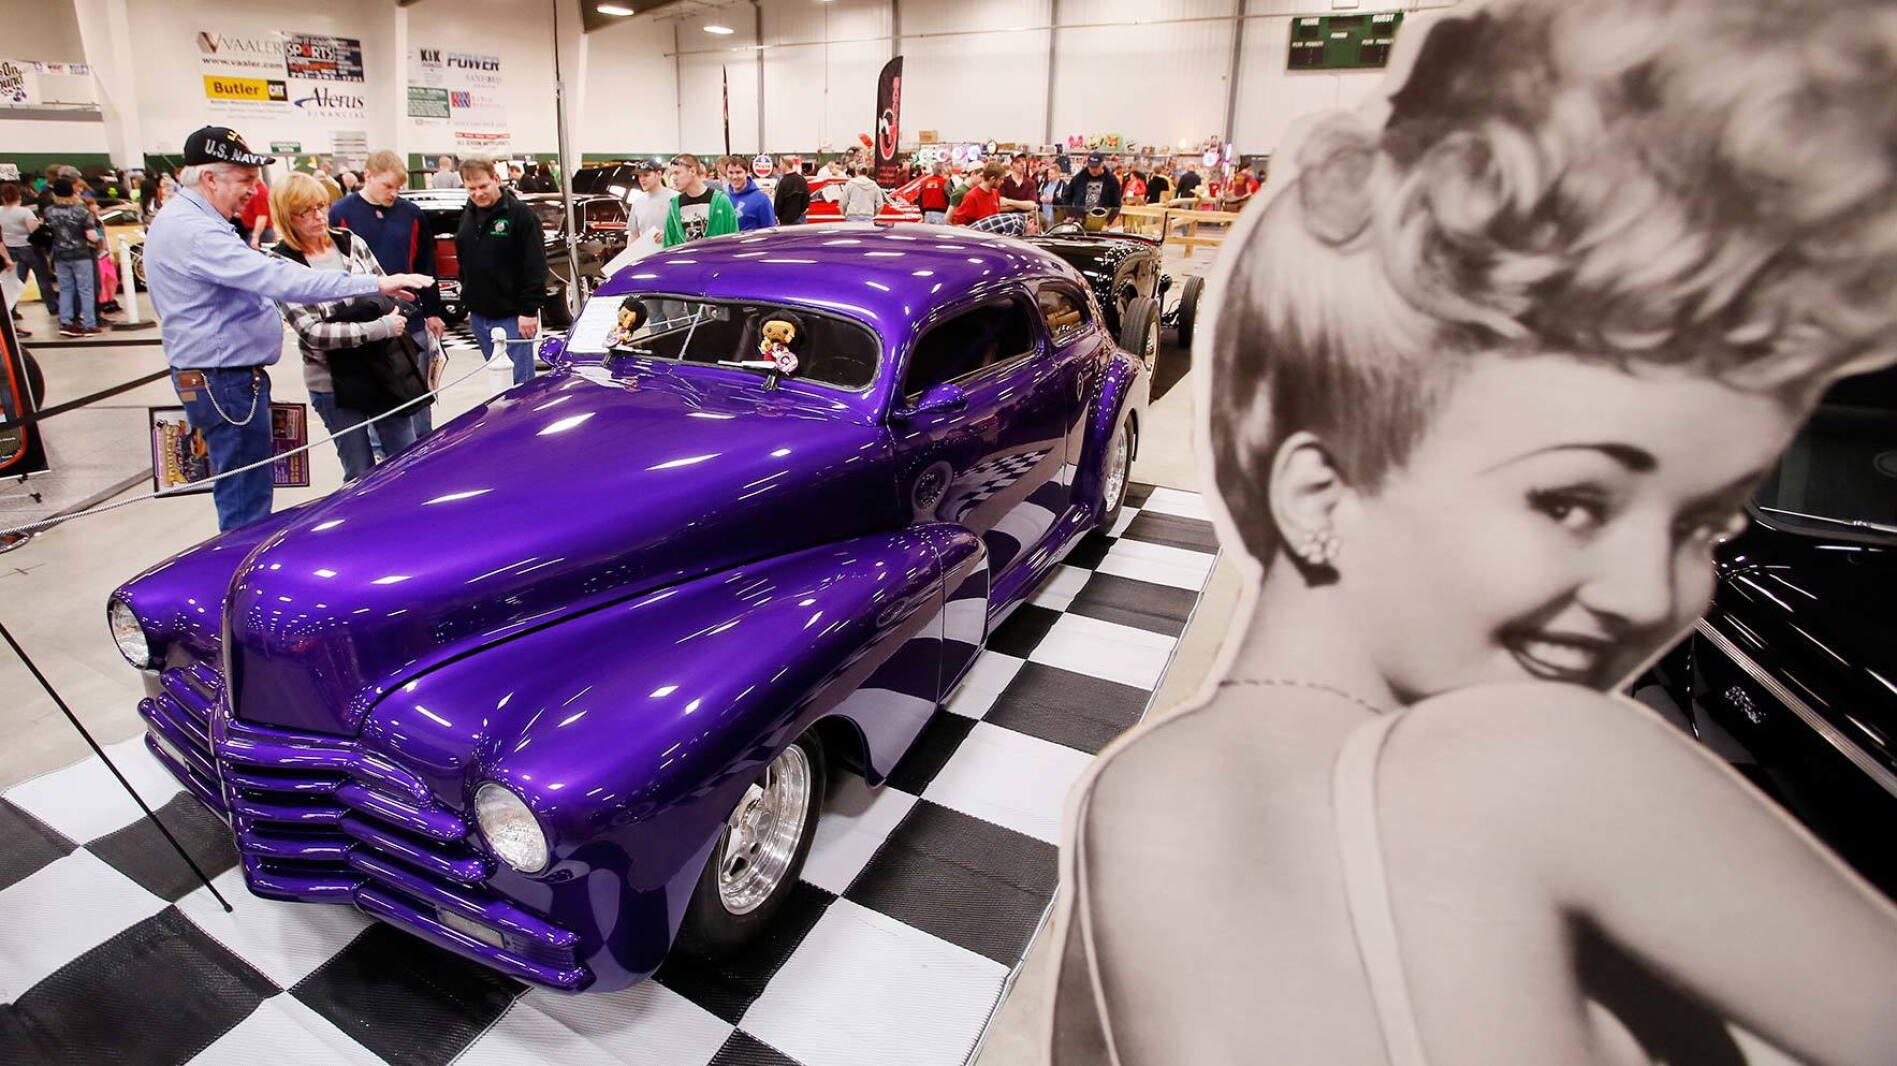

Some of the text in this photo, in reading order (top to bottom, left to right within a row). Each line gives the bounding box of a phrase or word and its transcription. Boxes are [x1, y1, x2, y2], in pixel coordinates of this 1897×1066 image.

[222, 37, 282, 54] VAALER
[286, 42, 336, 61] SPORTS
[201, 57, 284, 69] www.vaaler.com
[446, 54, 500, 71] POWER
[213, 81, 260, 95] Butler
[310, 87, 365, 109] Alerus
[204, 138, 268, 165] U.S. NAVY
